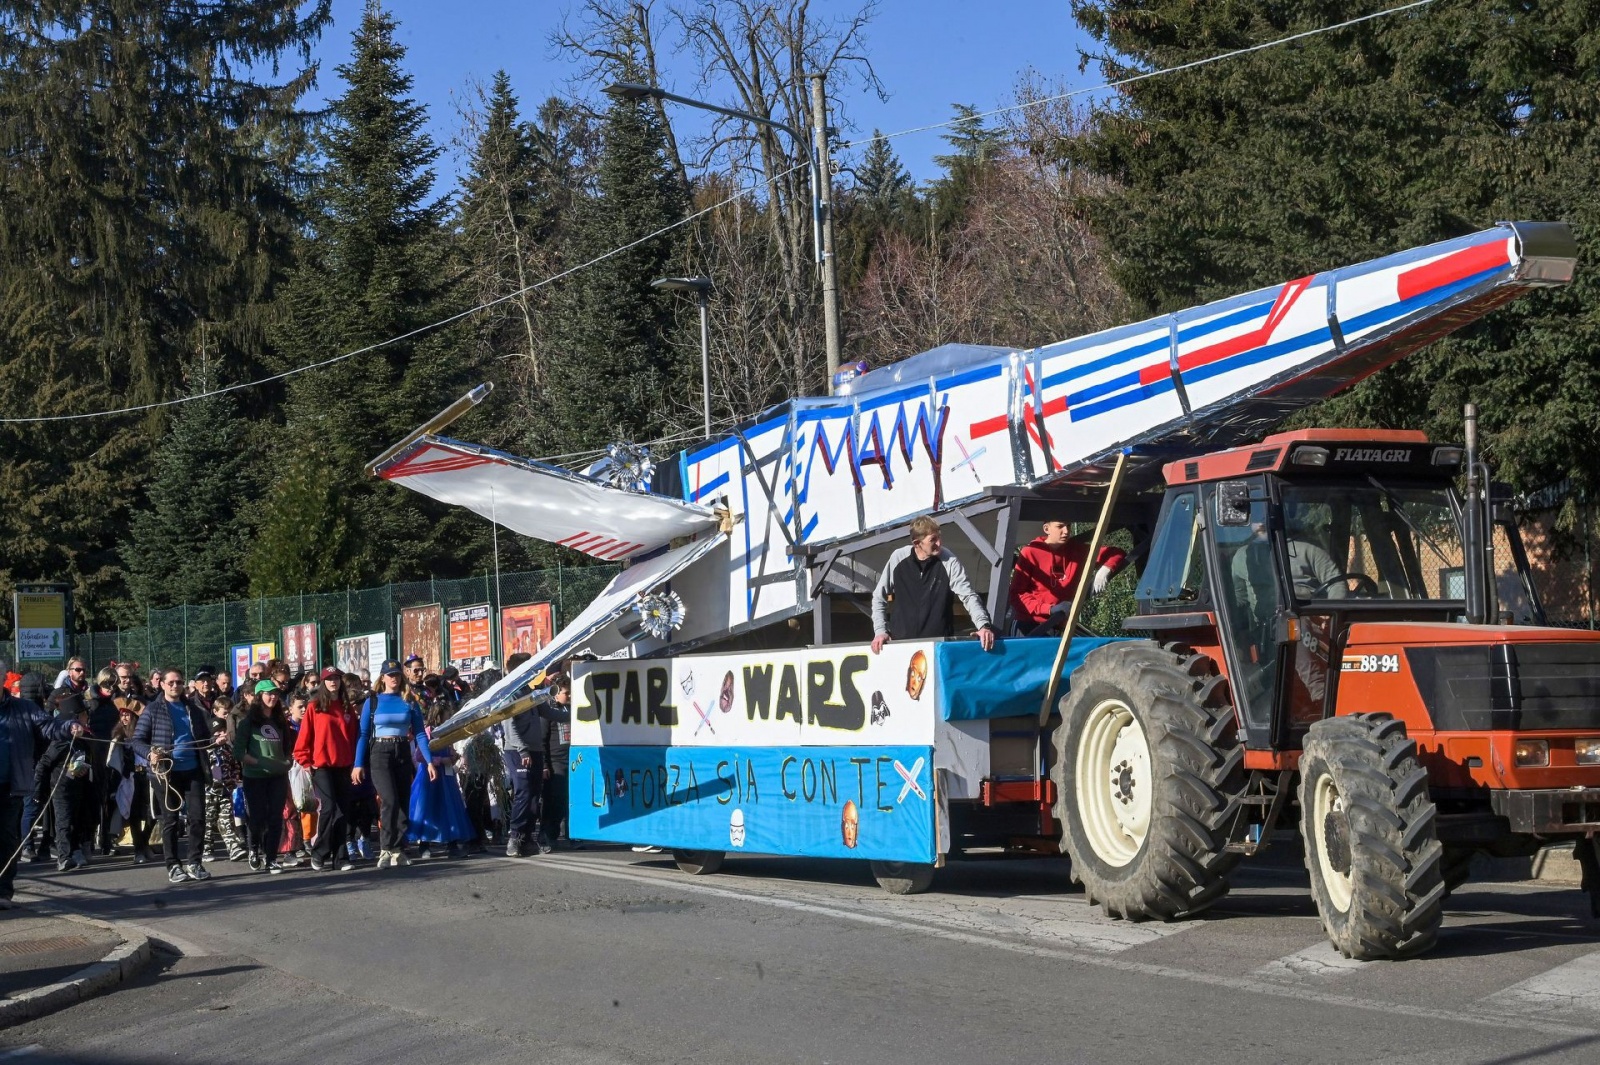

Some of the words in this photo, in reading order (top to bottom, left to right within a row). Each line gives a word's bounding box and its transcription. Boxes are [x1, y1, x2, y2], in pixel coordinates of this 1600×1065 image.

[1334, 448, 1412, 462] FIATAGRI
[1361, 654, 1399, 673] 88-94
[577, 666, 679, 726] STAR
[742, 653, 870, 732] WARS
[571, 752, 584, 772] CHE
[591, 768, 614, 808] LA
[630, 760, 700, 810] FORZA
[781, 755, 839, 806] CON
[850, 756, 894, 813] TE
